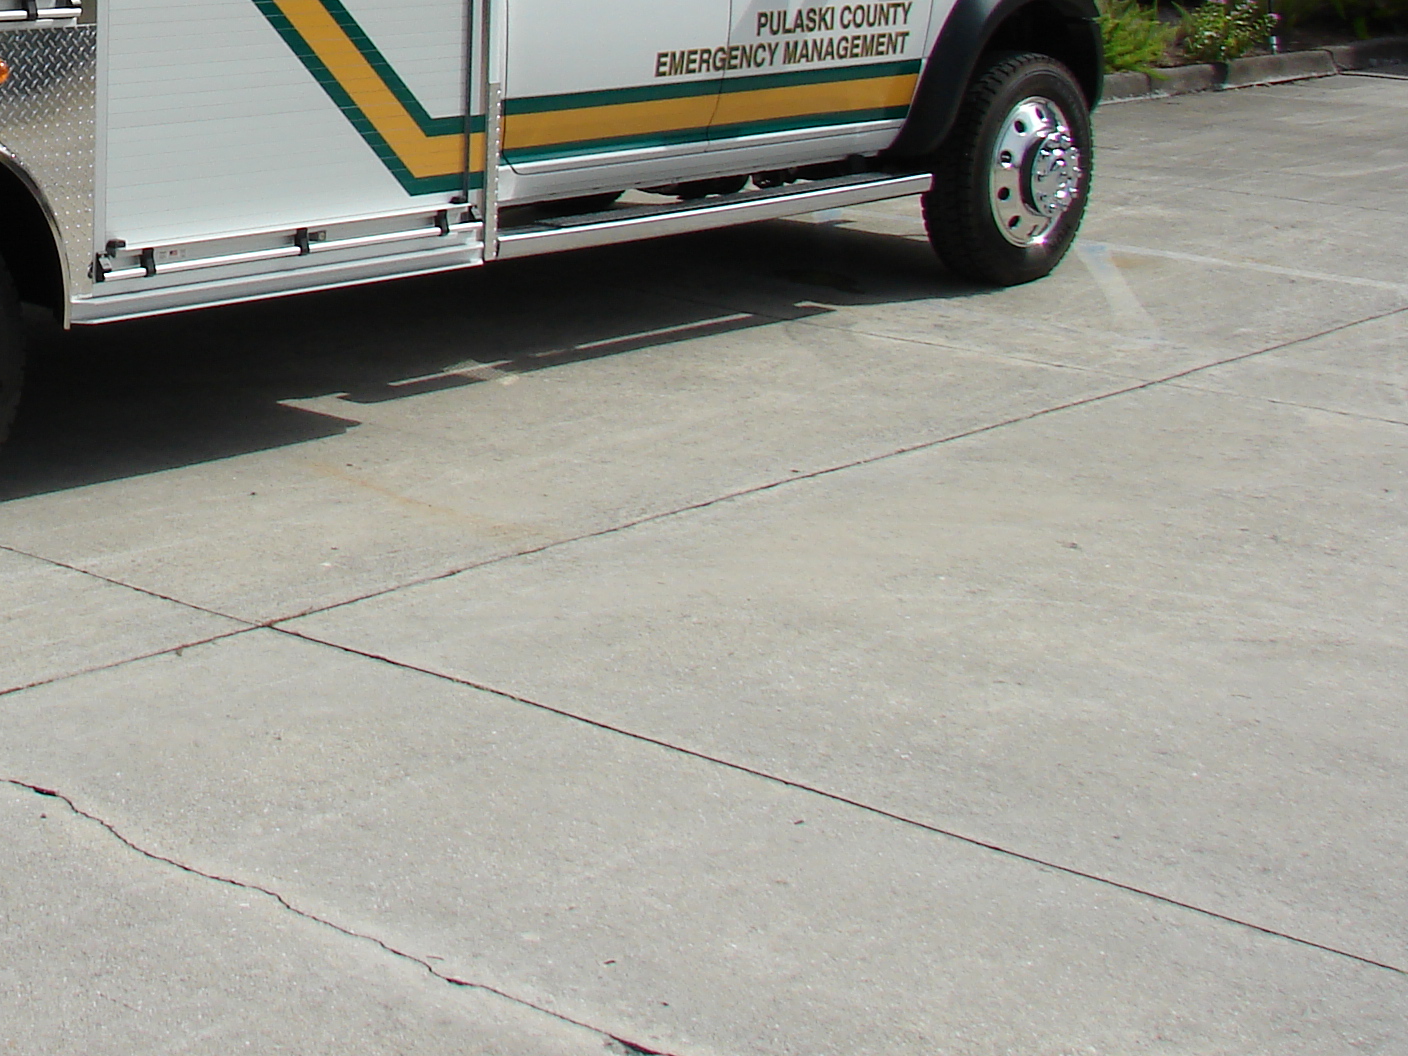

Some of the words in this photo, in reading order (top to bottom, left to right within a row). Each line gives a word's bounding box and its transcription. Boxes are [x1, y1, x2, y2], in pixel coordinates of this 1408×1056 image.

[756, 6, 835, 37] PULASKI
[840, 1, 913, 30] COUNTY
[654, 42, 779, 78] EMERGENCY
[782, 30, 911, 65] MANAGEMENT
